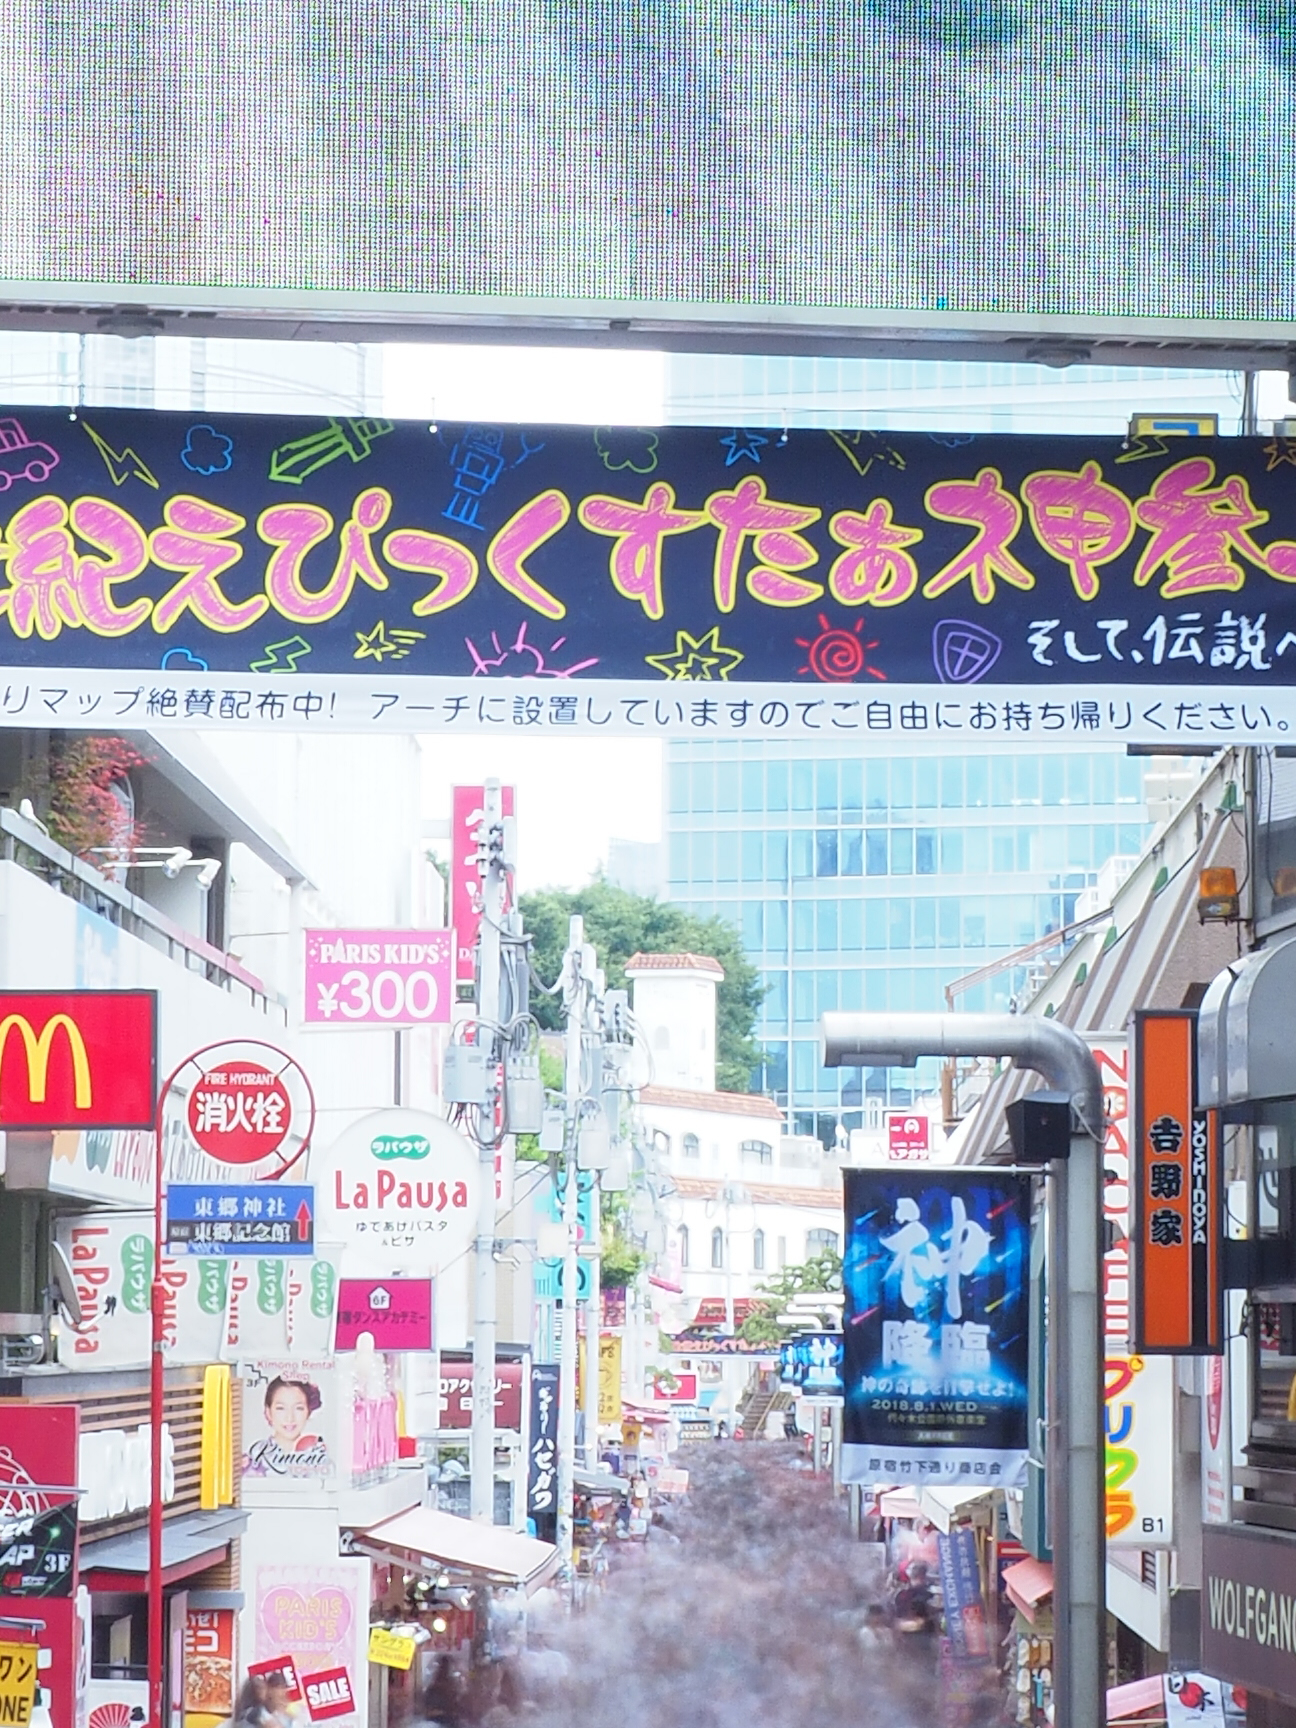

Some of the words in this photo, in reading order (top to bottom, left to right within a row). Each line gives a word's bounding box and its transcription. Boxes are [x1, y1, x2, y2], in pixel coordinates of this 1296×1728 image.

[320, 938, 381, 965] PARIS
[384, 942, 440, 965] KID'S
[317, 970, 438, 1020] ¥300
[195, 1090, 287, 1135] 消火栓
[335, 1169, 369, 1210] La
[377, 1168, 468, 1213] Pausa
[1148, 1114, 1184, 1248] 吉野家
[193, 1196, 288, 1218] 東郷神社
[878, 1196, 995, 1319] 神
[1141, 1517, 1165, 1534] B1
[306, 1675, 351, 1707] SALE
